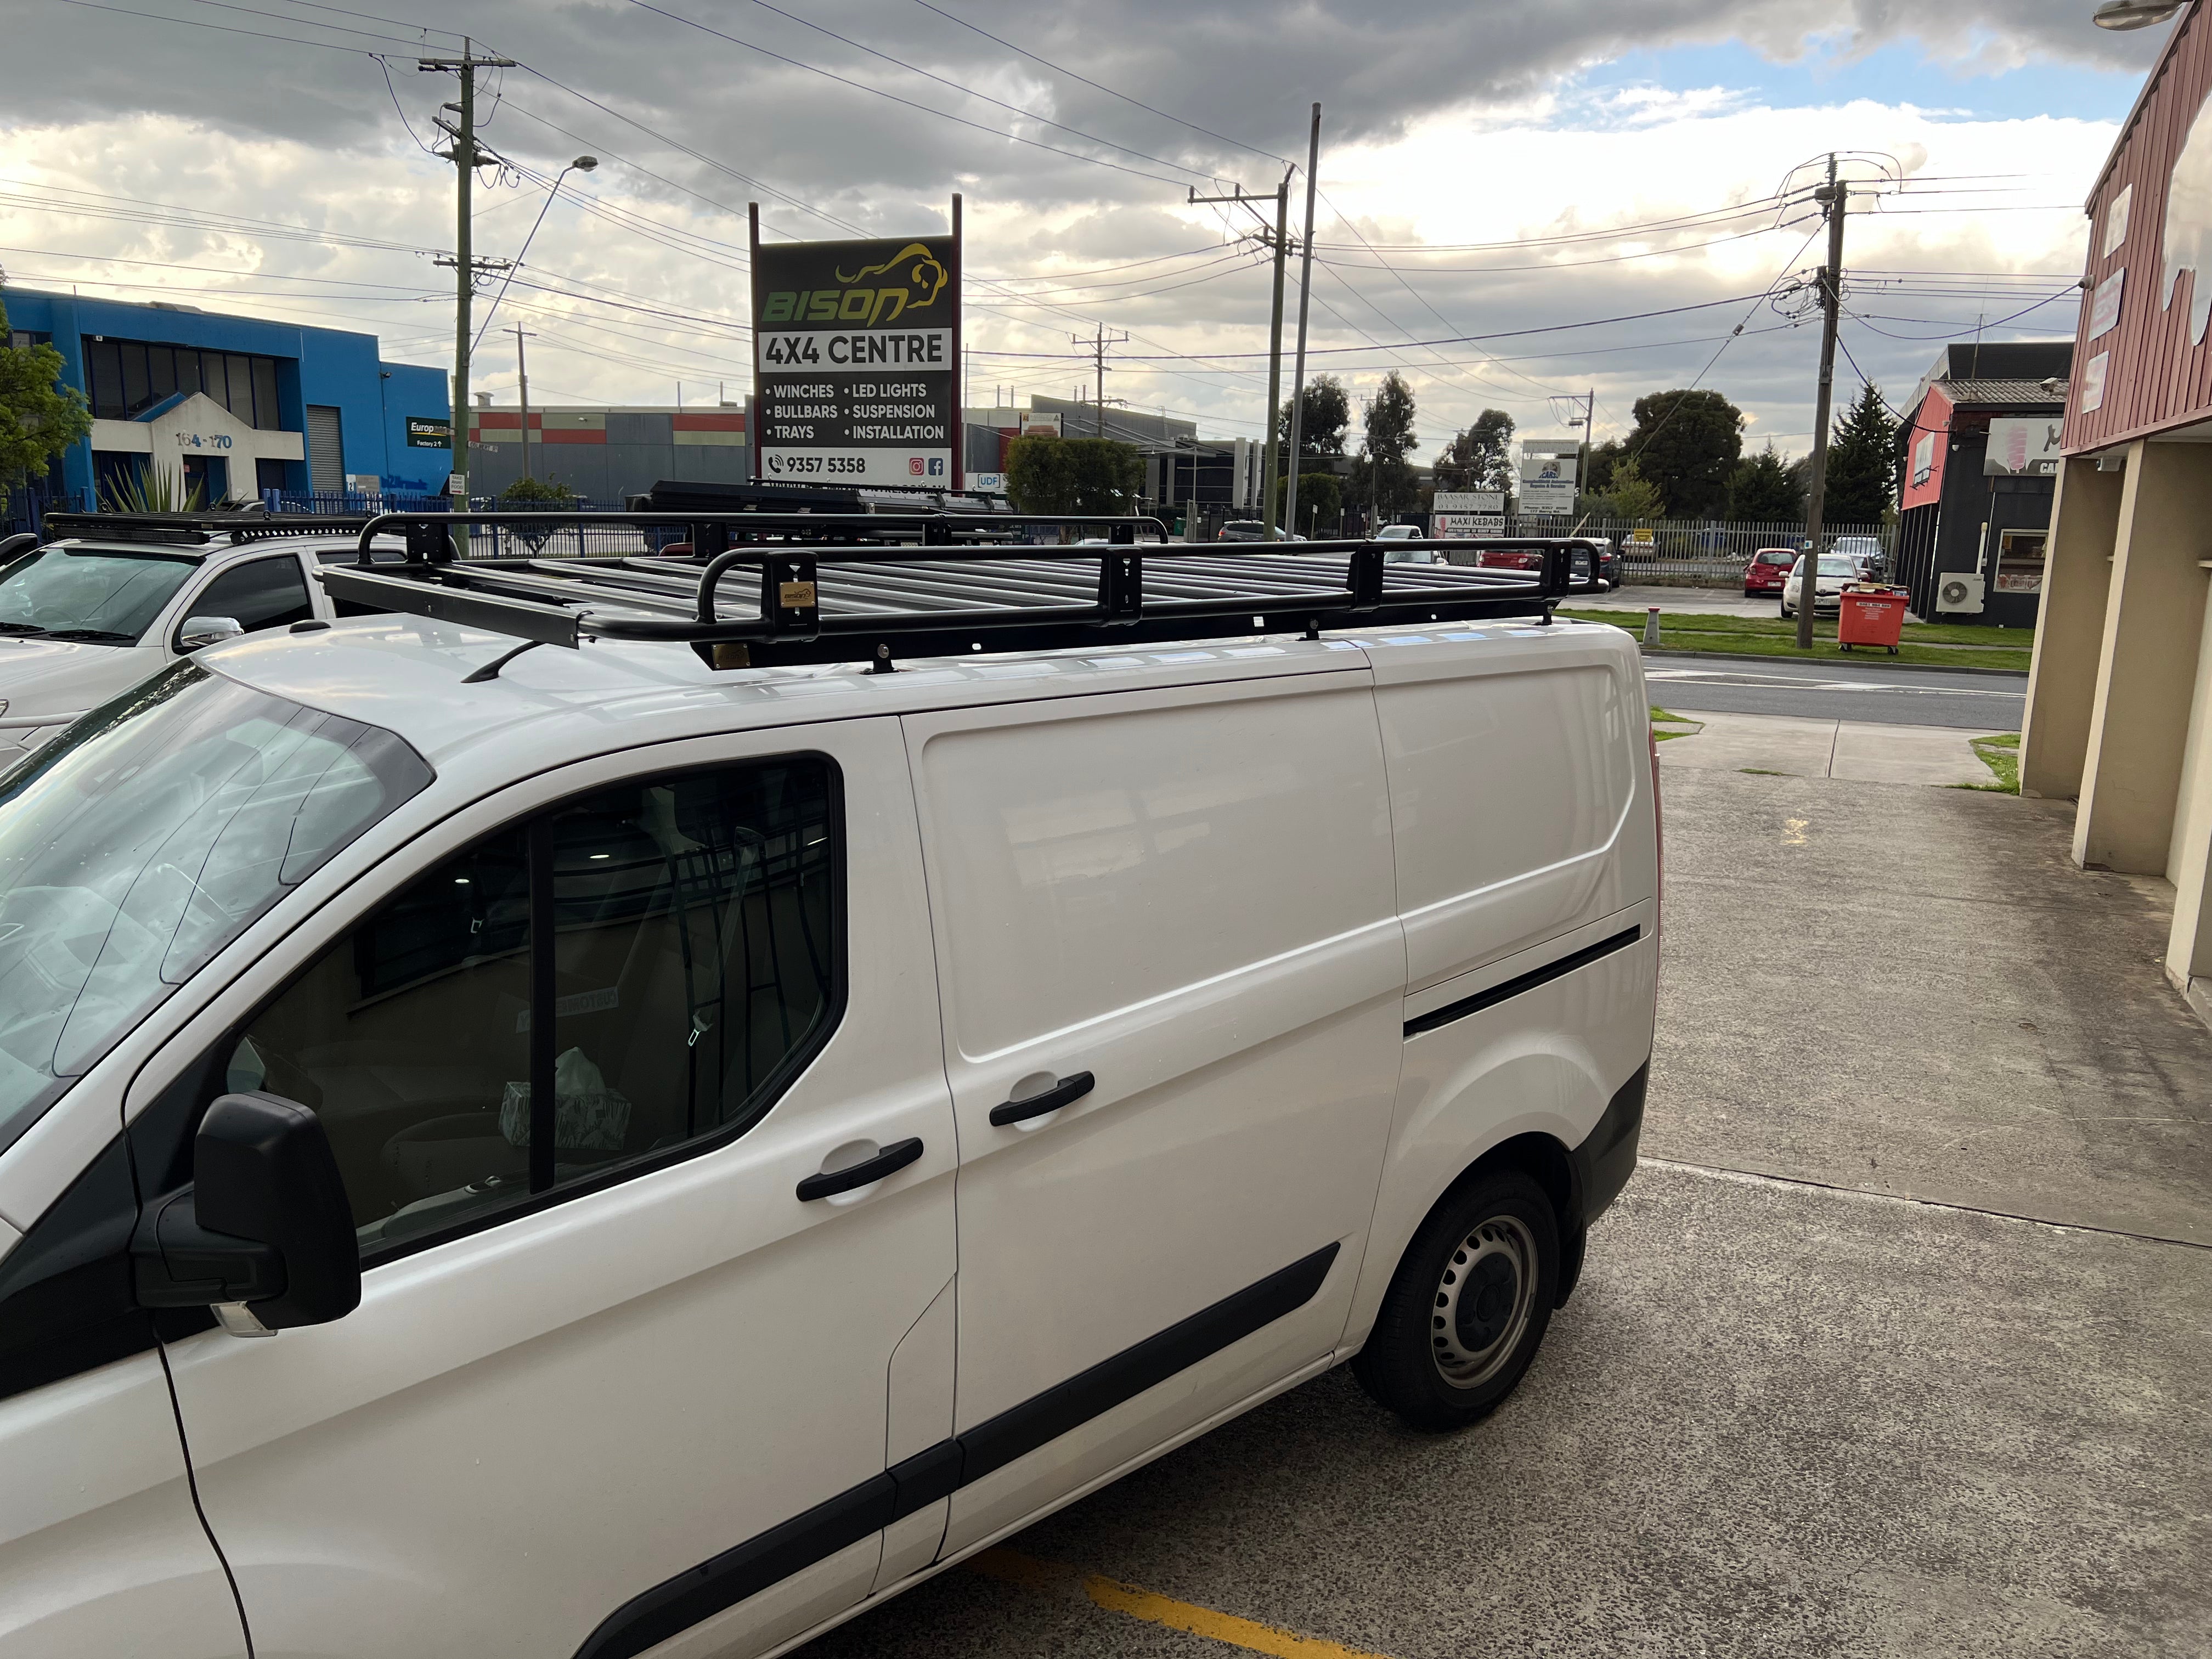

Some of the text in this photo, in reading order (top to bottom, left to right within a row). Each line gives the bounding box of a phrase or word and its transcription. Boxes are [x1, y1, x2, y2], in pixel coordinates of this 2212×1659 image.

[761, 287, 909, 328] BISON
[765, 334, 943, 365] 4X4 CENTRE
[774, 384, 834, 399] WINCHES
[852, 383, 927, 398] LED LIGHTS
[774, 405, 838, 419] BULLBARS
[852, 404, 935, 419] SUSPENSION
[774, 425, 815, 439] TRAYS
[852, 425, 944, 439] INSTALLATION
[786, 456, 866, 473] 9357 5358
[349, 482, 353, 491] 2
[980, 477, 997, 486] UDF
[1450, 517, 1504, 527] MAXI KEBABS
